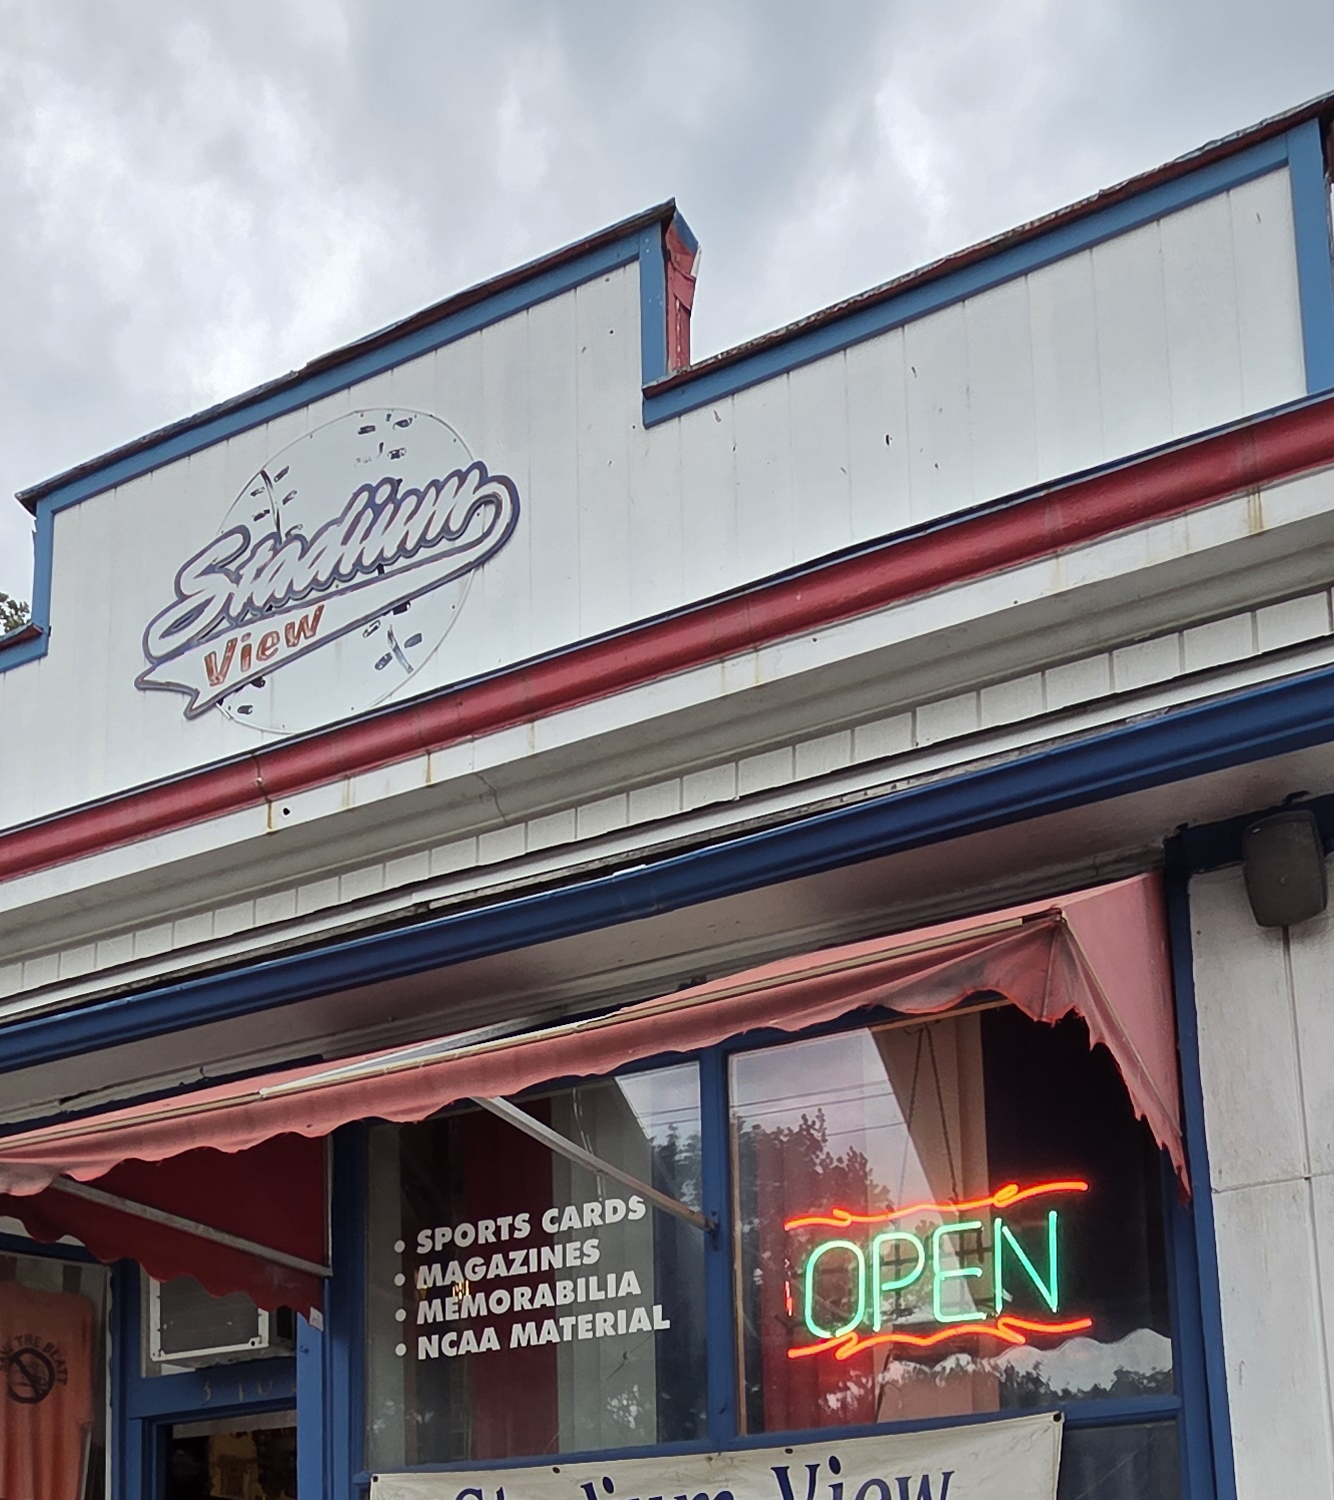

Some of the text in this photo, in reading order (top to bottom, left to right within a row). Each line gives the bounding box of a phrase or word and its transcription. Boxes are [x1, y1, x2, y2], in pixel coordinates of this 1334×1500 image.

[144, 460, 513, 662] Stadium
[204, 604, 325, 687] View
[417, 1195, 646, 1254] SPORTS CARDS
[417, 1238, 600, 1290] MAGAZINES
[803, 1210, 1060, 1340] OPEN
[417, 1270, 642, 1325] MEMORABILIA
[418, 1304, 671, 1360] NCAA MATERIAL
